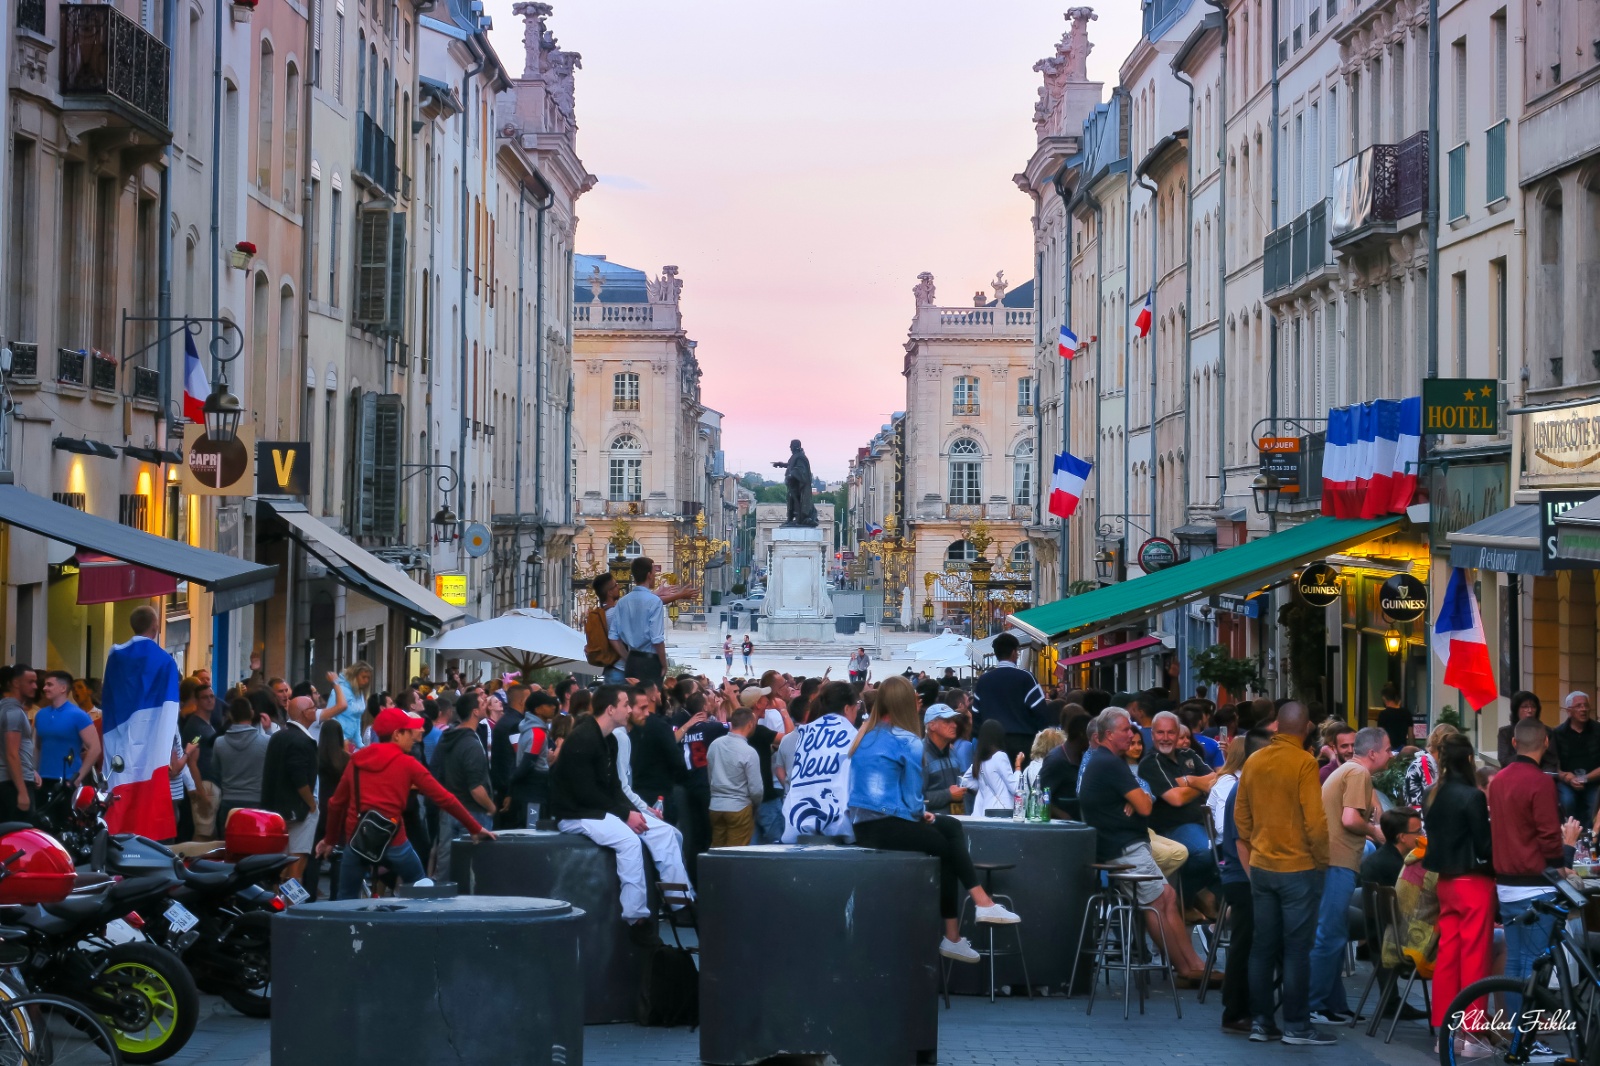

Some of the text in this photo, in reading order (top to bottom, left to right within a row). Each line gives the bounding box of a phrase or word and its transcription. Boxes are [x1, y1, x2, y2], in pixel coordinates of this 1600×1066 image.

[1428, 405, 1493, 429] HOTEL
[272, 449, 296, 487] V
[892, 490, 902, 544] HOTE
[1479, 546, 1517, 571] Restaurant
[1301, 584, 1339, 595] GUINNESS
[1382, 599, 1425, 609] GUINNESS
[791, 752, 840, 780] Bleus
